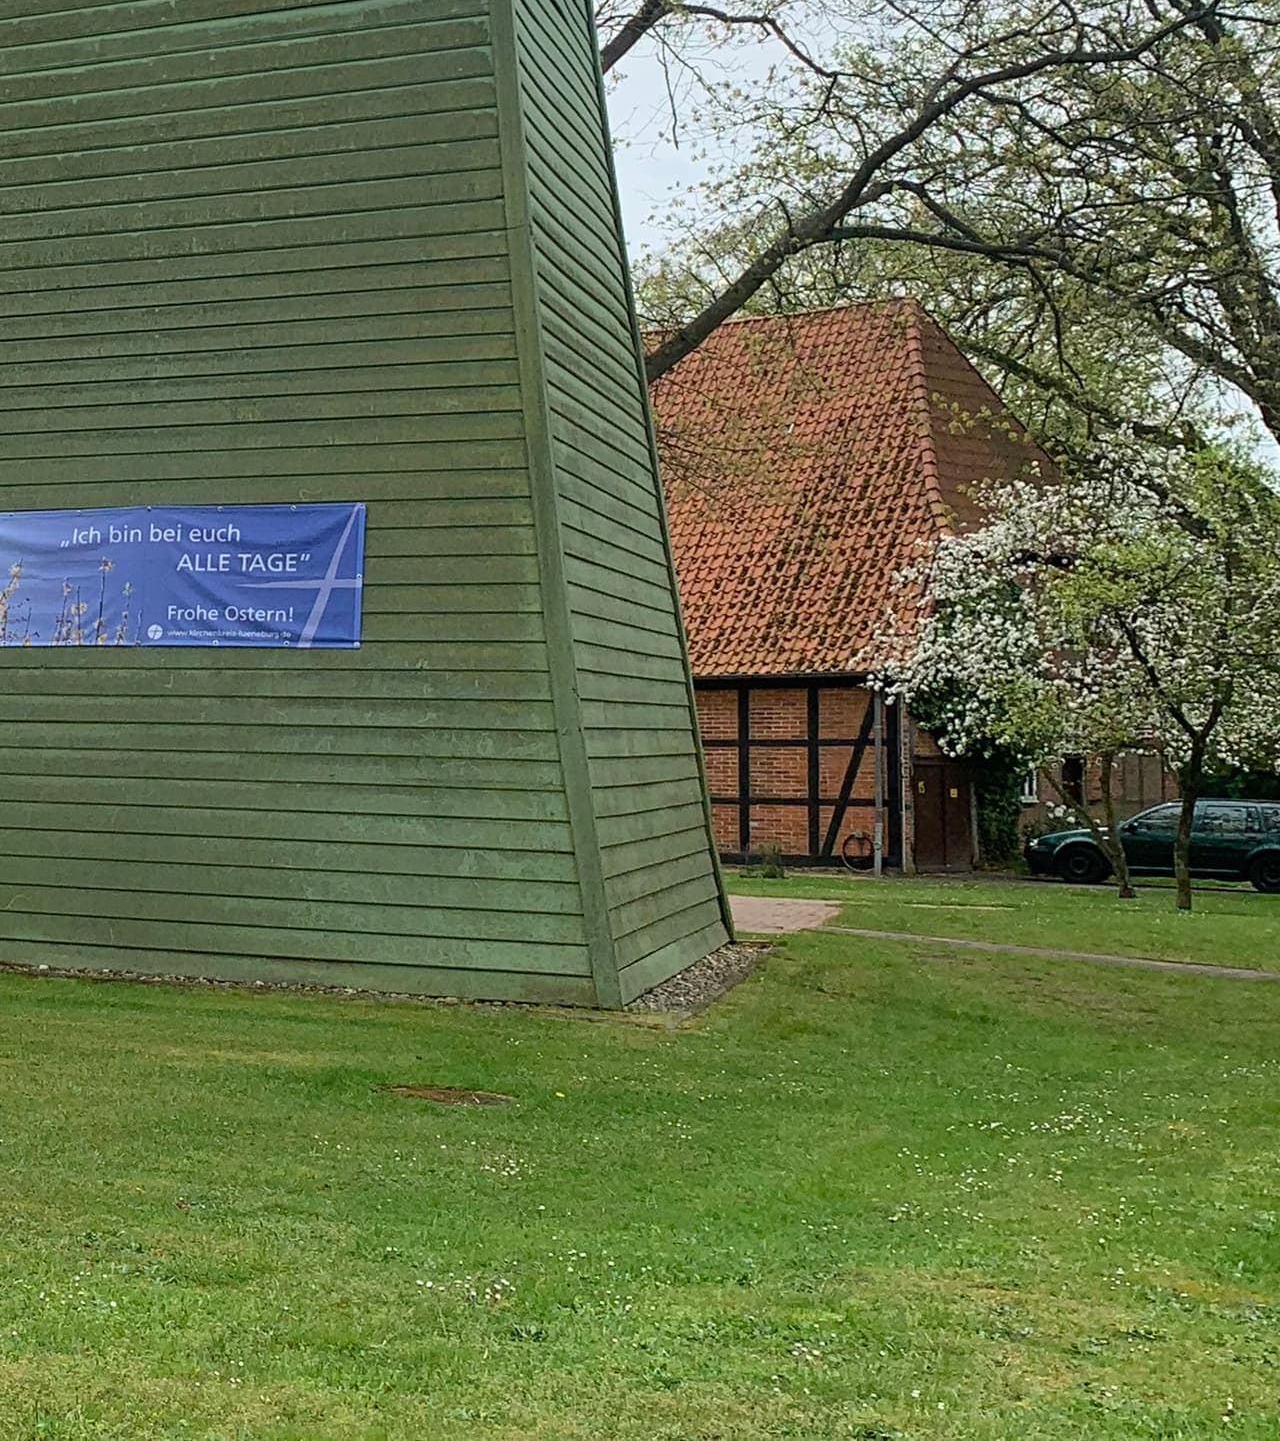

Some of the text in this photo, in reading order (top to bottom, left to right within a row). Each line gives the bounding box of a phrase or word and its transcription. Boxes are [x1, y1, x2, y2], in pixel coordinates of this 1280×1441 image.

[60, 523, 240, 548] „Ich bin bei euch
[176, 553, 310, 572] ALLE TAGE“
[167, 605, 294, 622] Frohe Ostern!
